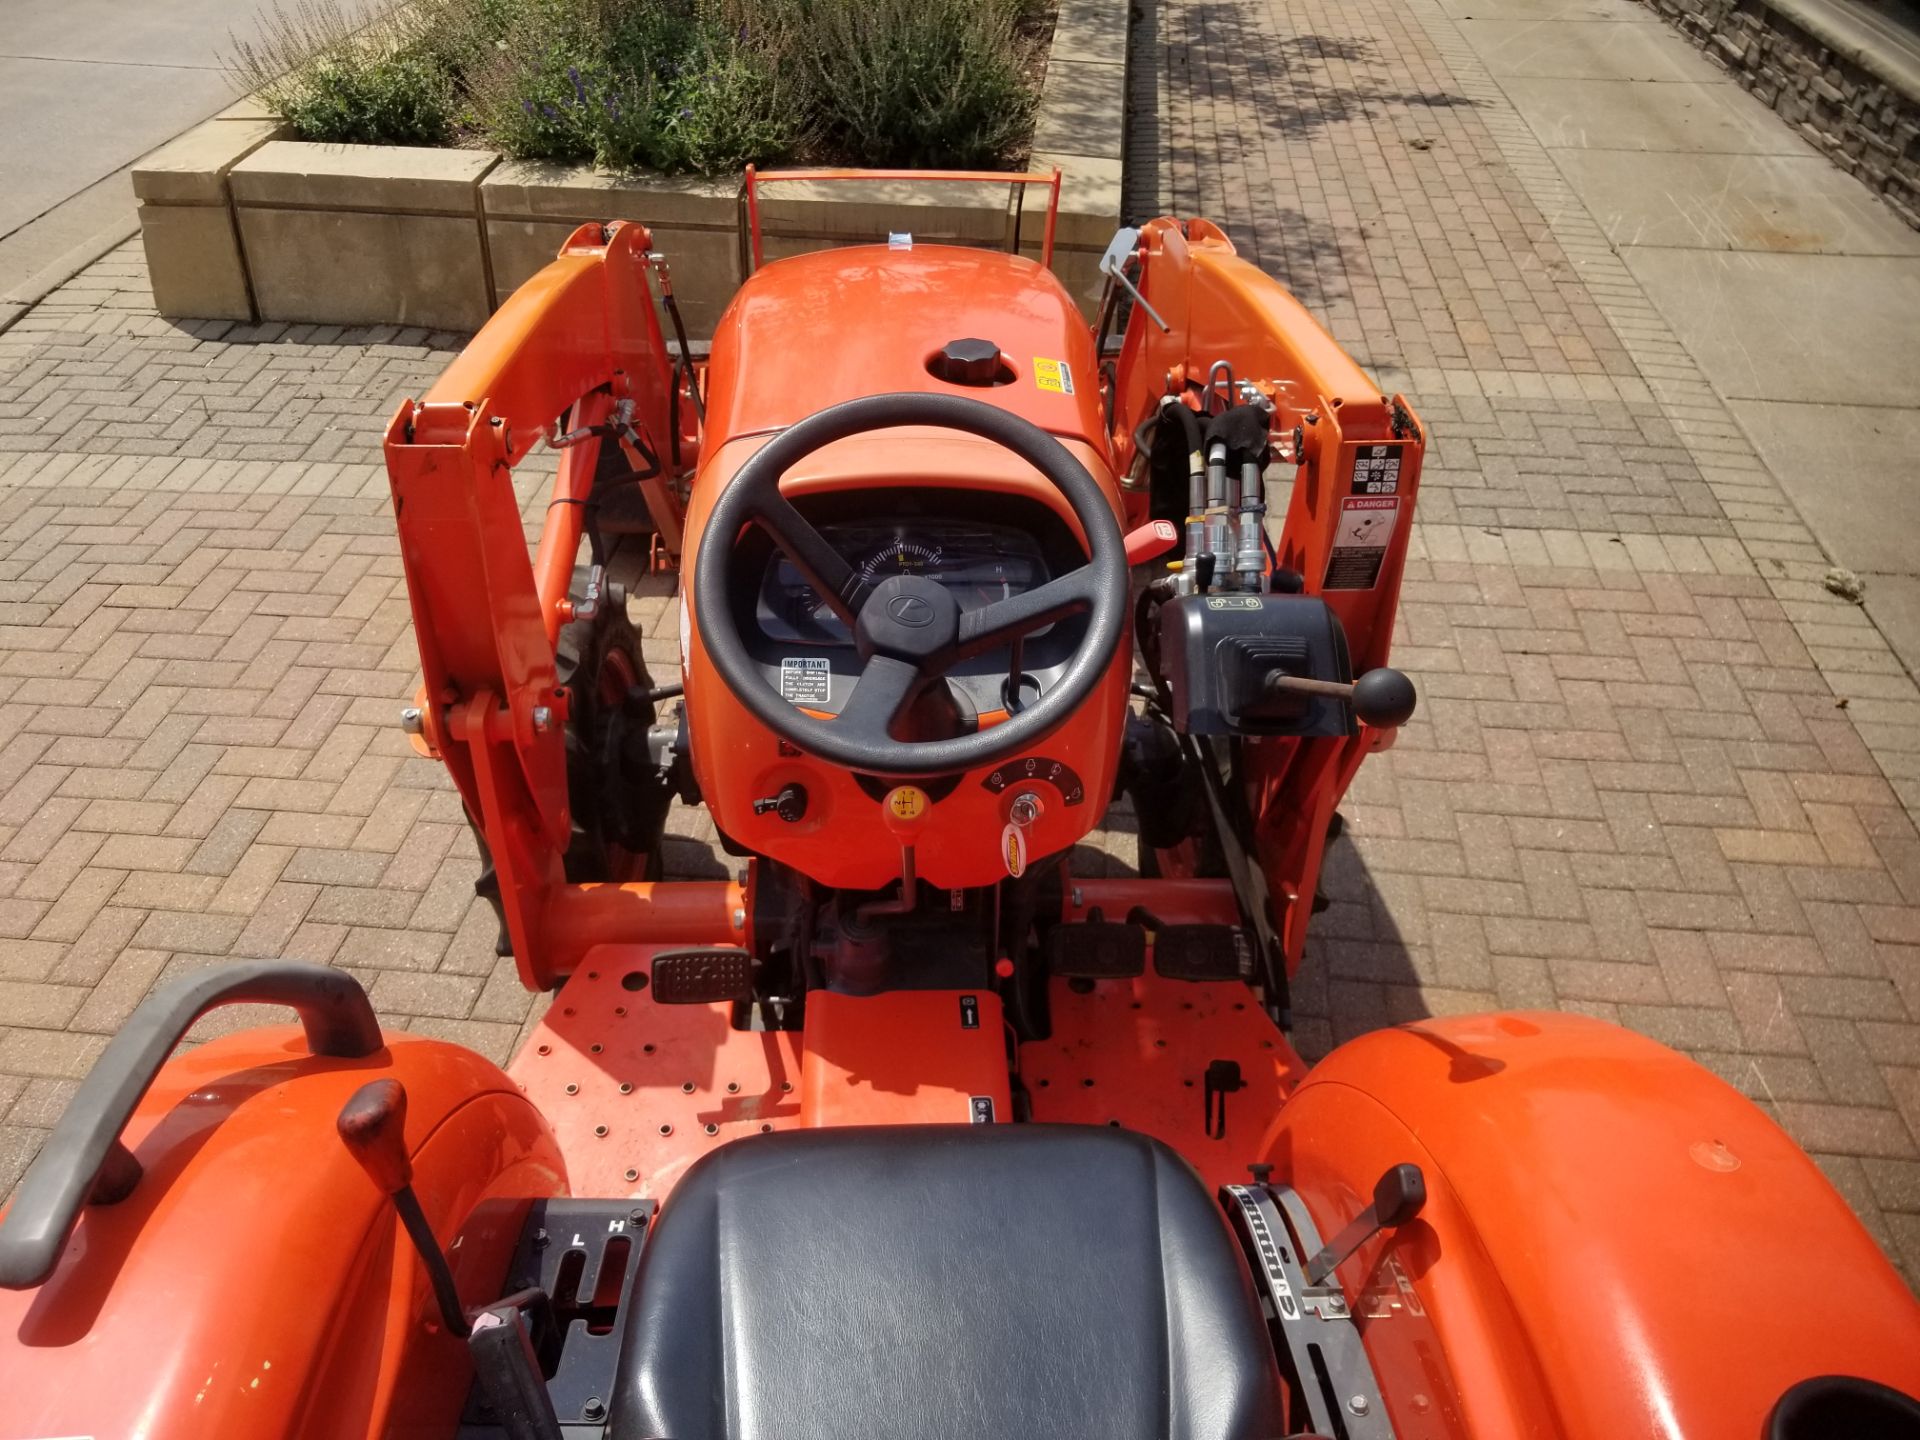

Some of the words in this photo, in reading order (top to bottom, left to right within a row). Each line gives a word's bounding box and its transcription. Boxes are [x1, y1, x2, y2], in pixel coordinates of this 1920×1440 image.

[1356, 500, 1394, 508] DANGER
[894, 536, 900, 545] 2
[936, 546, 942, 555] 3
[995, 566, 1002, 574] H
[784, 660, 826, 669] IMPORTANT
[608, 1220, 625, 1232] H
[571, 1233, 585, 1246] L
